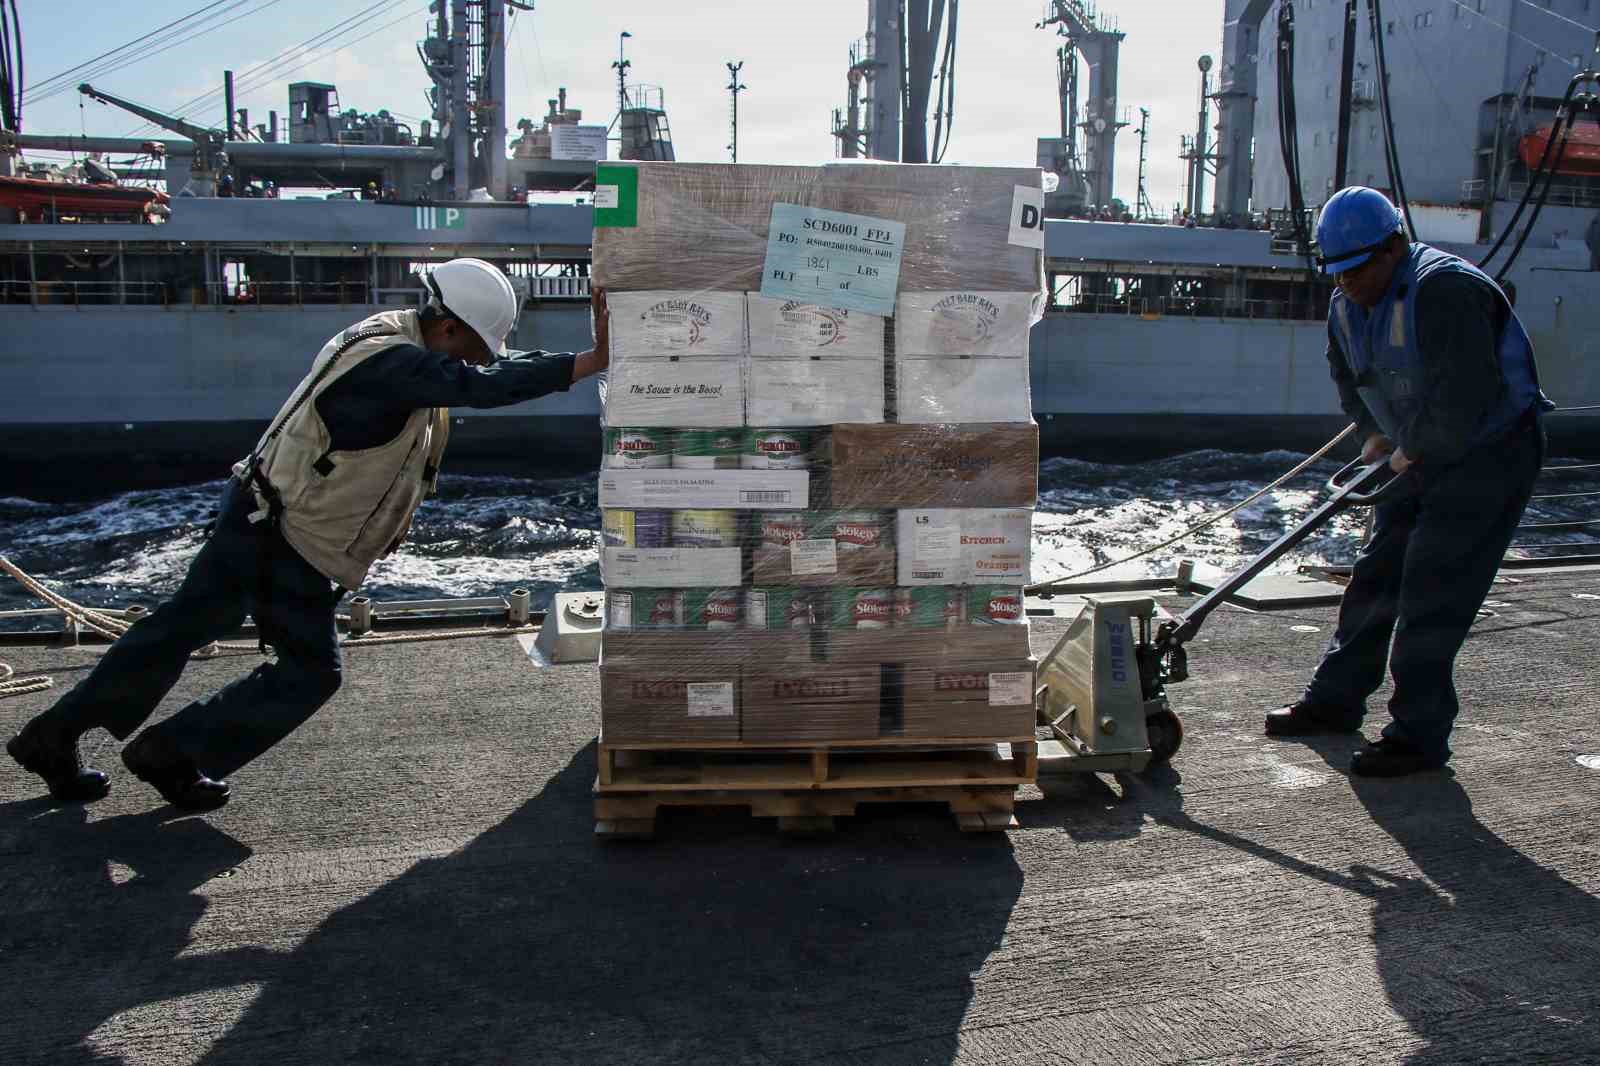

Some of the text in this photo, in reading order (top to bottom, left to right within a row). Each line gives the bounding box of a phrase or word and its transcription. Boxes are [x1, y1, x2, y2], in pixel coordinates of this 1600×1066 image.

[445, 207, 460, 227] P
[1021, 204, 1043, 231] D
[803, 218, 891, 241] SCD6001 FPJ
[777, 232, 799, 245] PO:
[773, 269, 795, 282] PLT
[857, 265, 880, 277] LBS
[839, 281, 852, 290] of
[630, 384, 722, 396] The Sauce is the Boss!
